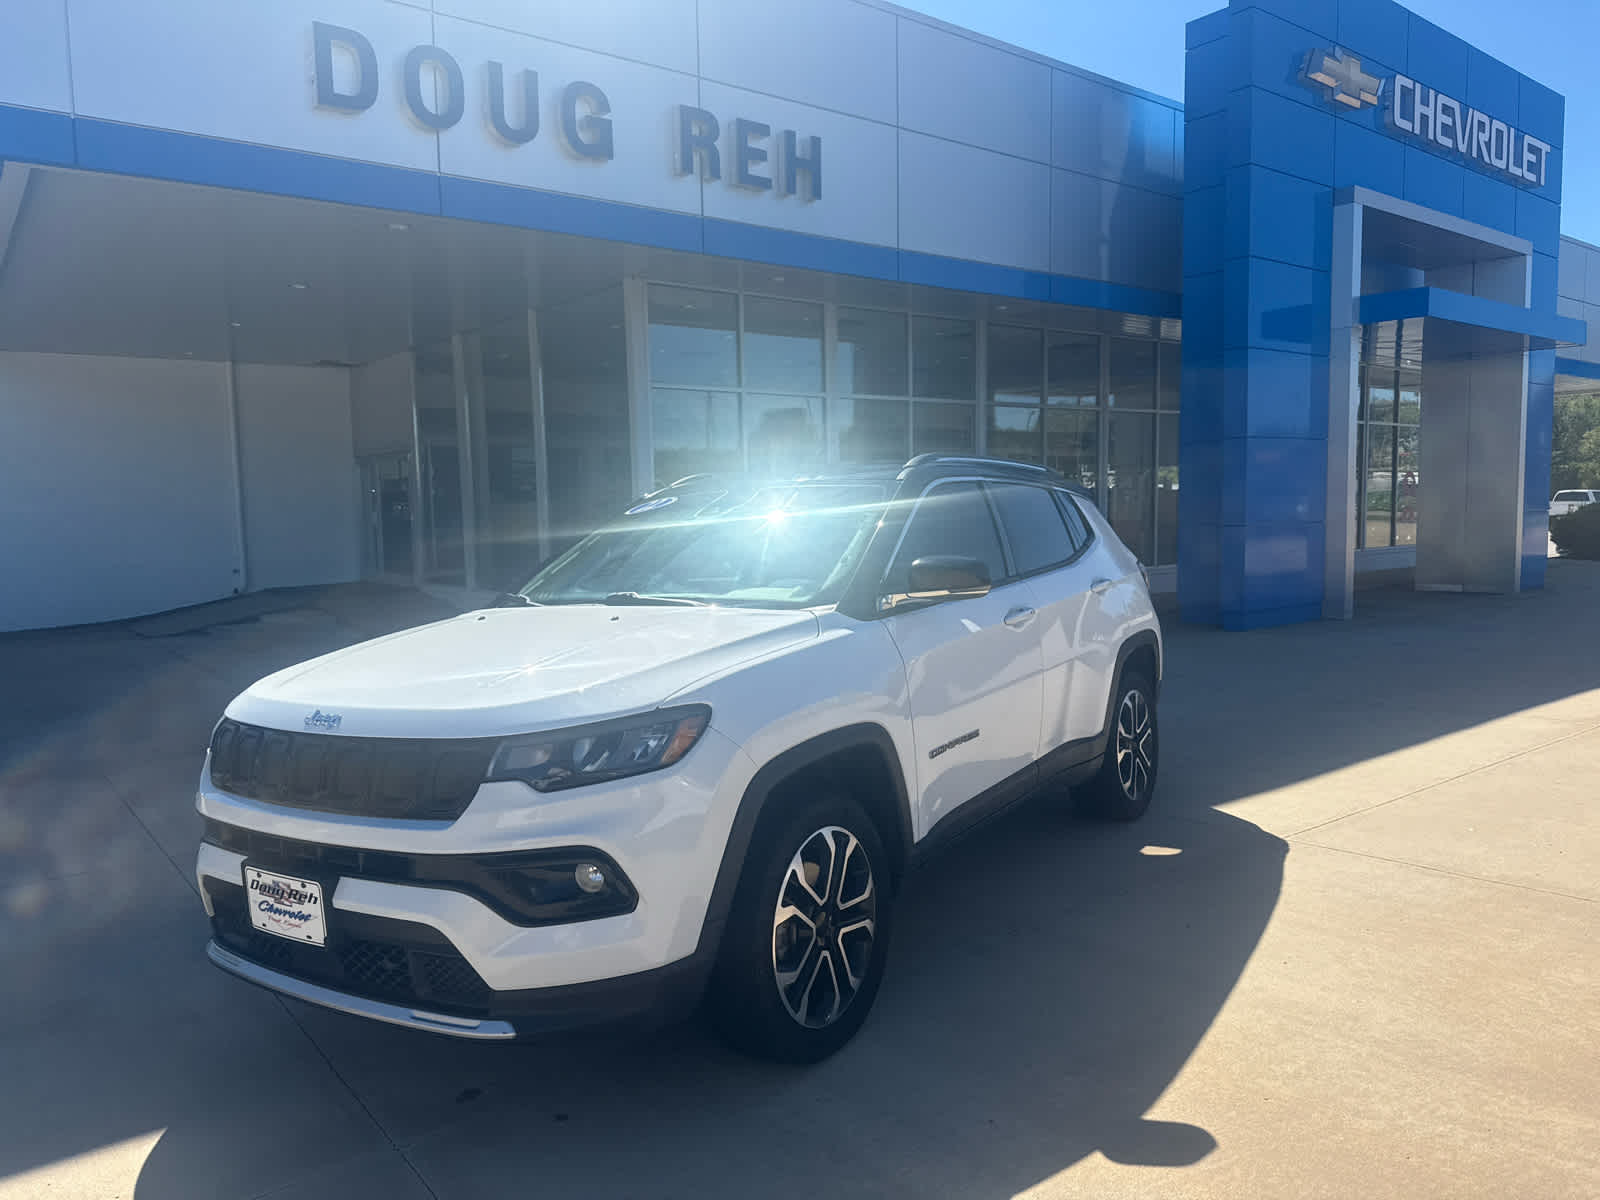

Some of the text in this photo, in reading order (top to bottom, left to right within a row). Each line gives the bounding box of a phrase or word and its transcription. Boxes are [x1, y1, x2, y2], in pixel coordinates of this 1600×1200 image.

[311, 20, 823, 201] DOUG REH
[1392, 73, 1551, 187] CHEVROLET
[250, 879, 319, 905] Doug Reh
[258, 900, 312, 922] Chevrolet
